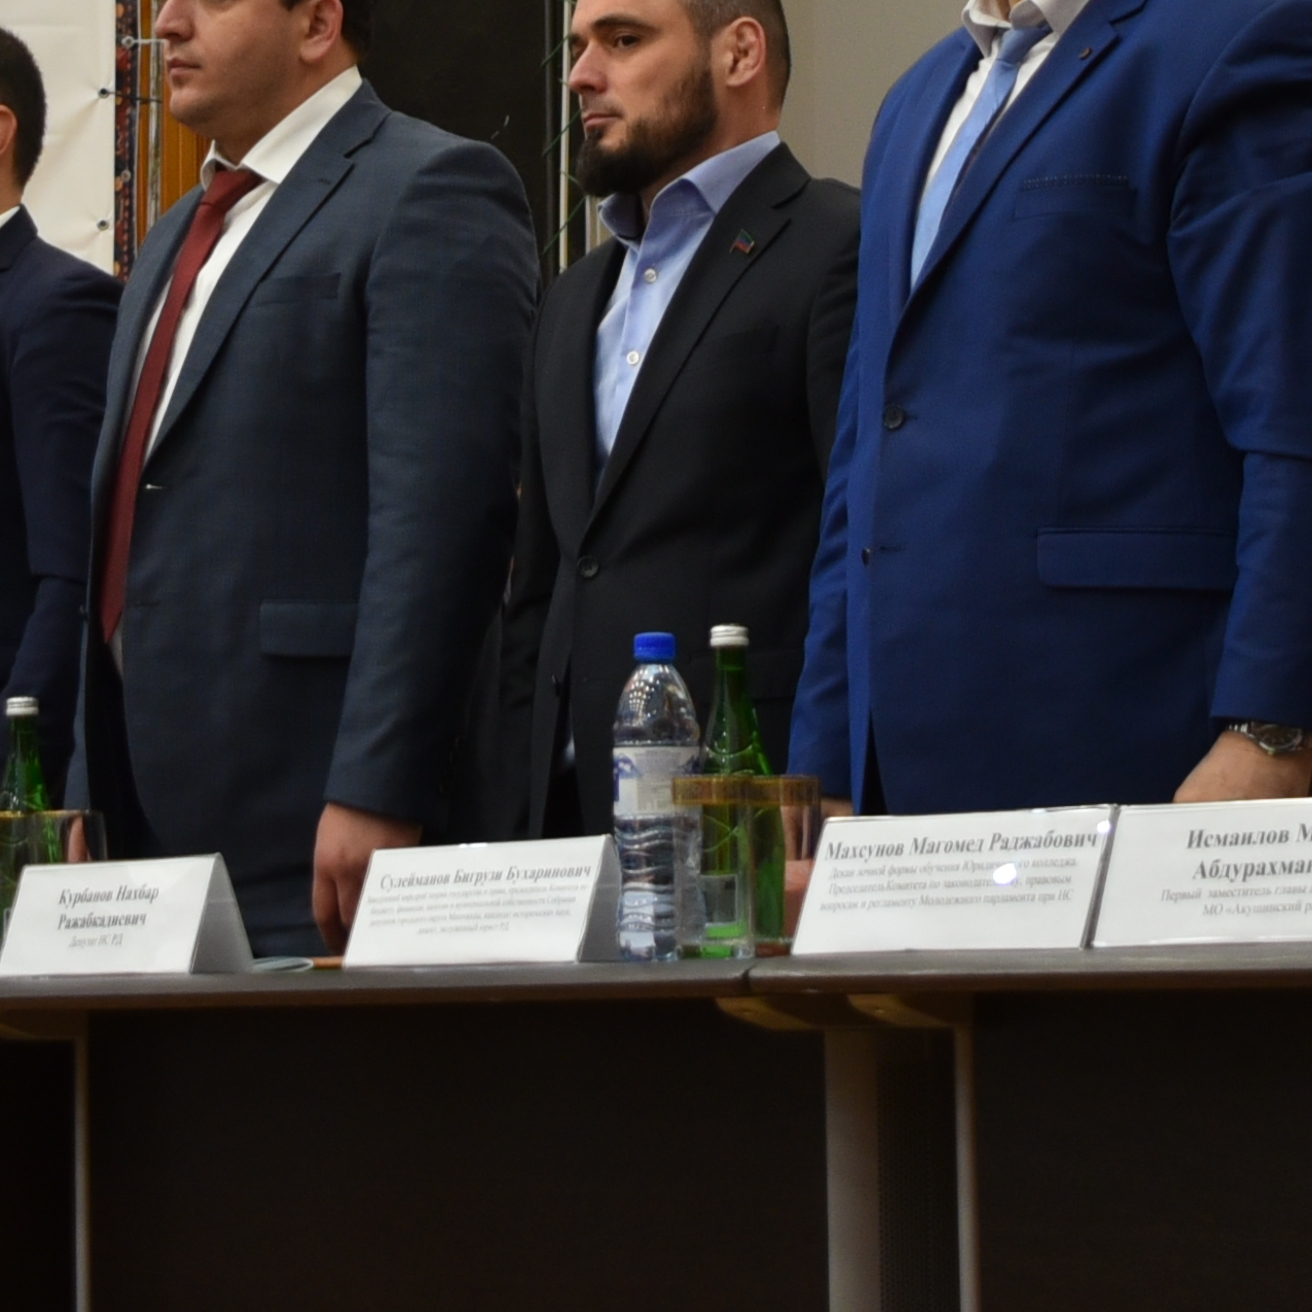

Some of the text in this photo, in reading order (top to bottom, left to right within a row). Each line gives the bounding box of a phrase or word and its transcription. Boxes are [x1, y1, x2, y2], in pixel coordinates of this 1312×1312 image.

[825, 828, 1098, 864] Махсунов Магомед Раджабович
[1186, 827, 1290, 851] Исмаилов
[379, 872, 451, 893] Сулейманов
[58, 888, 113, 910] Курбанов
[1160, 887, 1202, 903] Первый
[1201, 902, 1224, 916] МО
